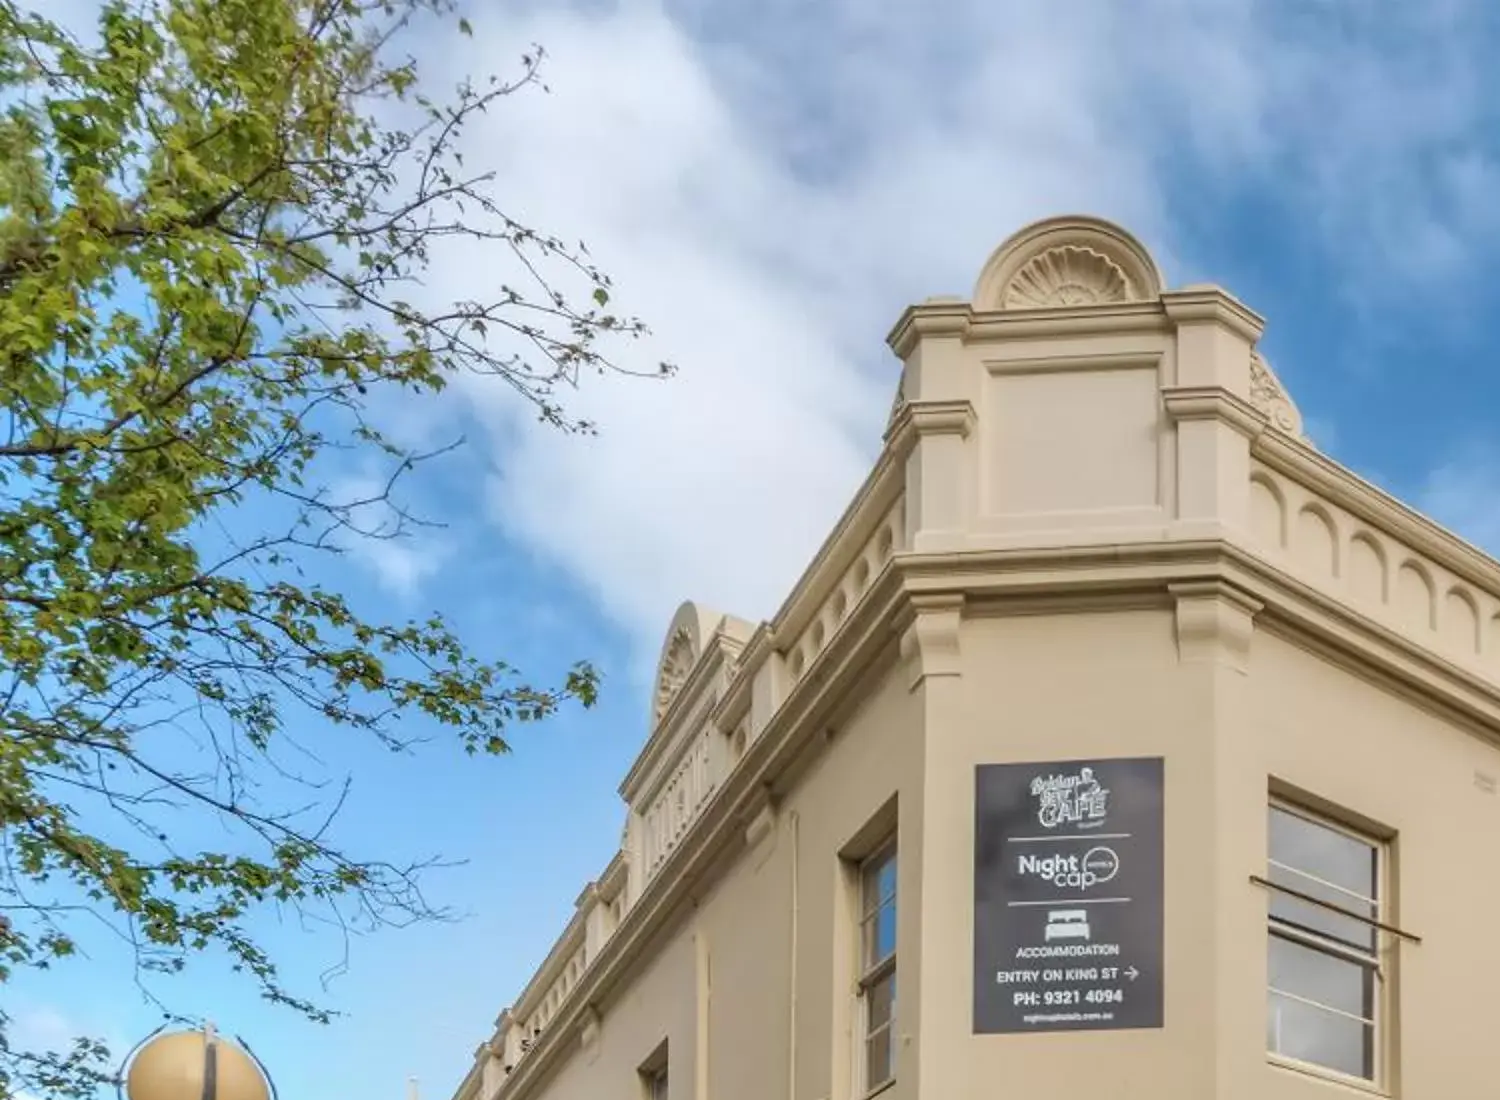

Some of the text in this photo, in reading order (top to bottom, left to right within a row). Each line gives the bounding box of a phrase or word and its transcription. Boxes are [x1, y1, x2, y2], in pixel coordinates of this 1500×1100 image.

[1018, 853, 1078, 880] Night
[1055, 872, 1096, 890] cap
[1016, 944, 1119, 958] ACCOMMODATION
[996, 967, 1119, 983] ENTRY ON KING ST
[1013, 989, 1123, 1006] PH: 9321 4094
